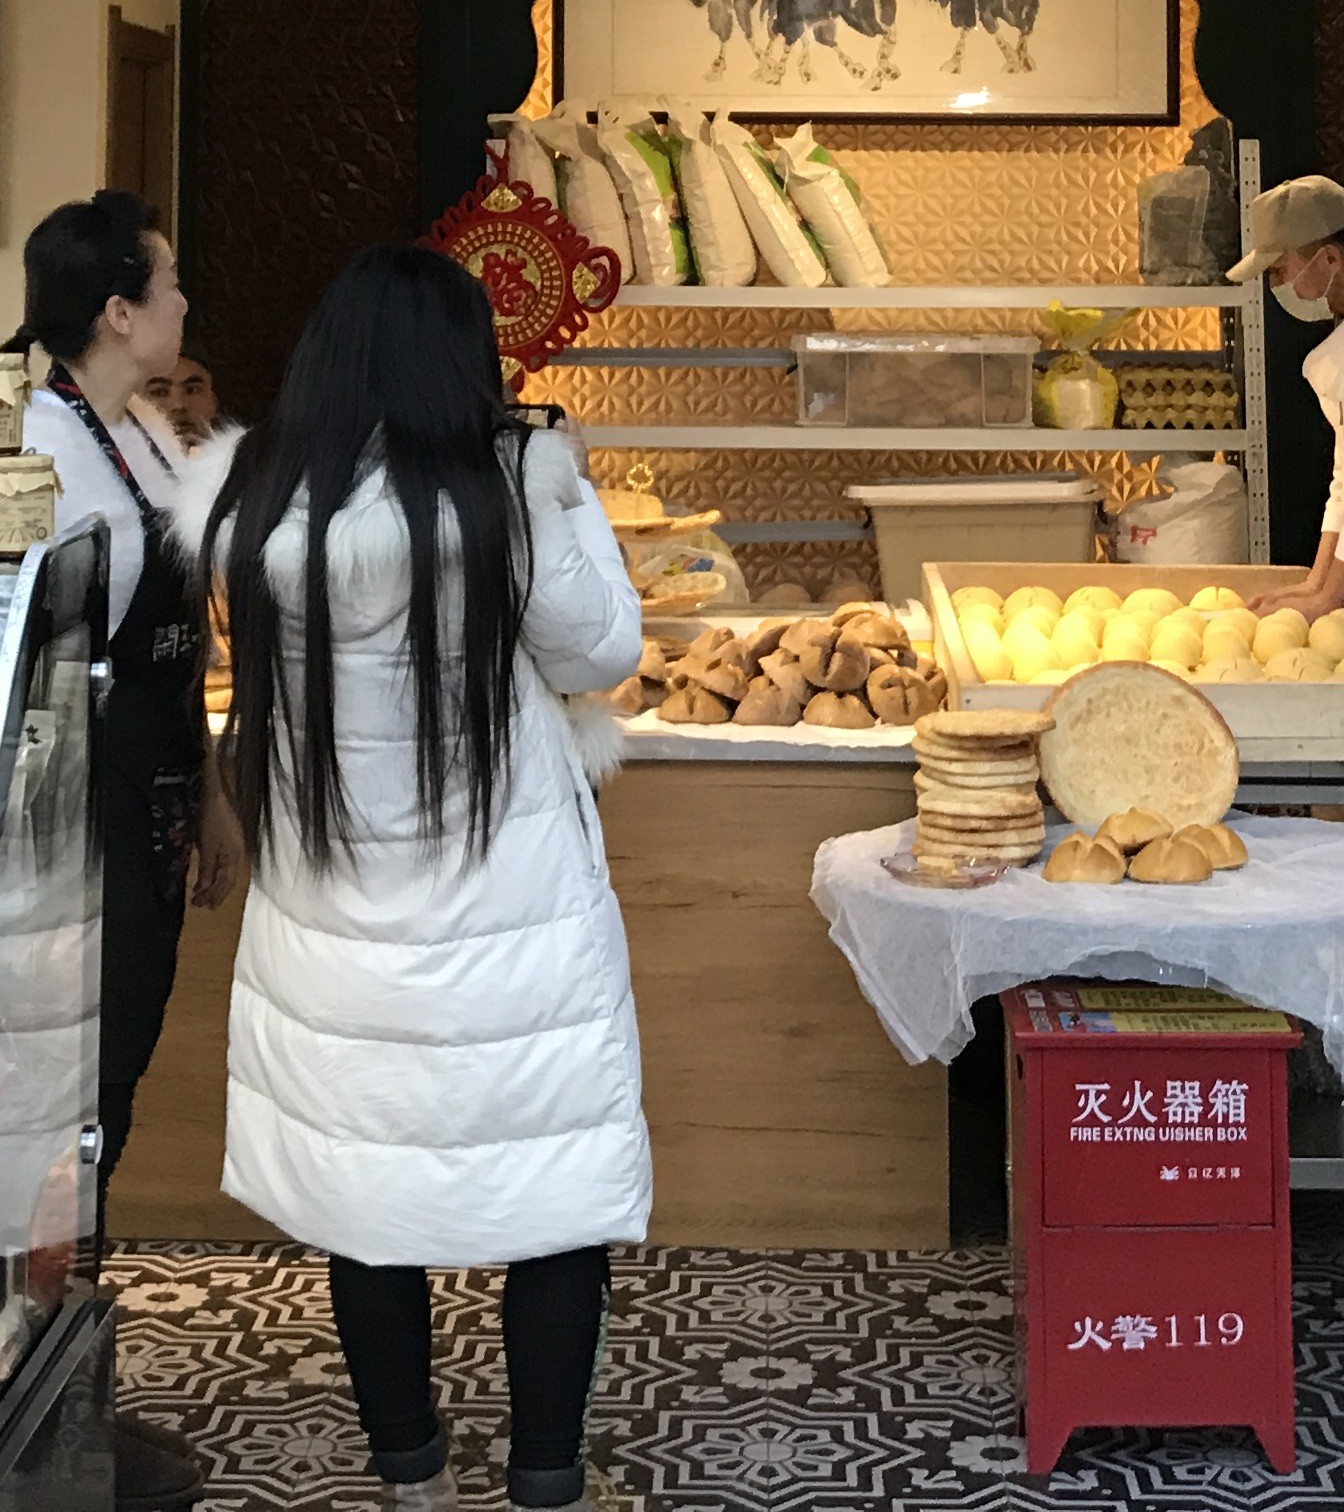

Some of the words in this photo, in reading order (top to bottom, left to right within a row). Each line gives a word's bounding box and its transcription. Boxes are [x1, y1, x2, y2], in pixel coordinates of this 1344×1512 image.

[1071, 1079, 1250, 1125] 灭火器箱
[1070, 1126, 1101, 1142] FIRE
[1217, 1126, 1248, 1142] BOX
[1067, 1311, 1245, 1352] 火警119
